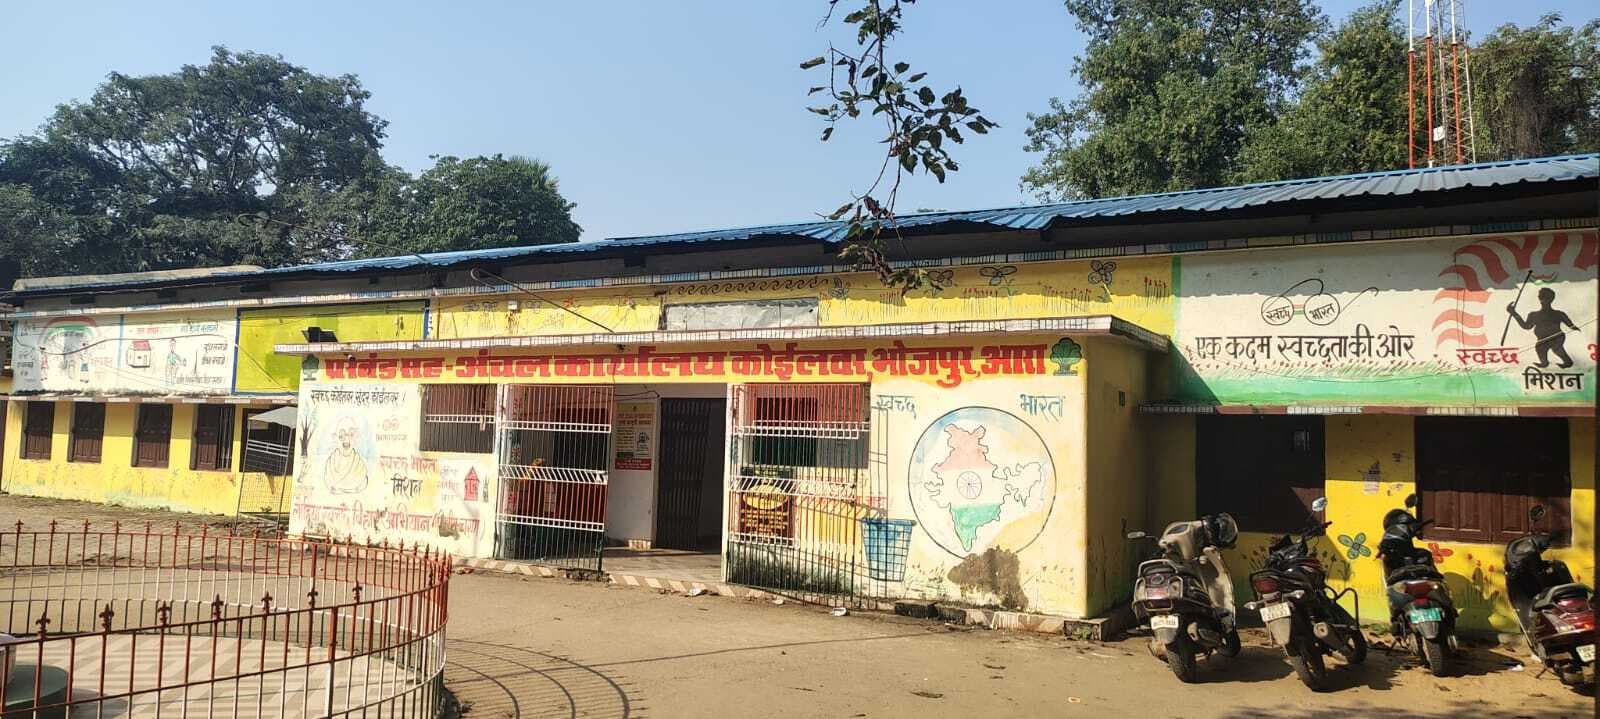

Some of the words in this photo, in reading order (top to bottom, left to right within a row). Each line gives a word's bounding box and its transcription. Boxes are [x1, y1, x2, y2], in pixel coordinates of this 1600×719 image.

[1309, 303, 1335, 320] भारत
[1195, 336, 1223, 359] एक
[1226, 336, 1273, 365] कदम
[1376, 326, 1415, 360] ओर
[1456, 347, 1519, 365] स्वच्छ
[1521, 366, 1585, 390] मिशन
[1020, 394, 1065, 422] भारत
[410, 454, 438, 474] भारत
[390, 473, 424, 500] मिशन
